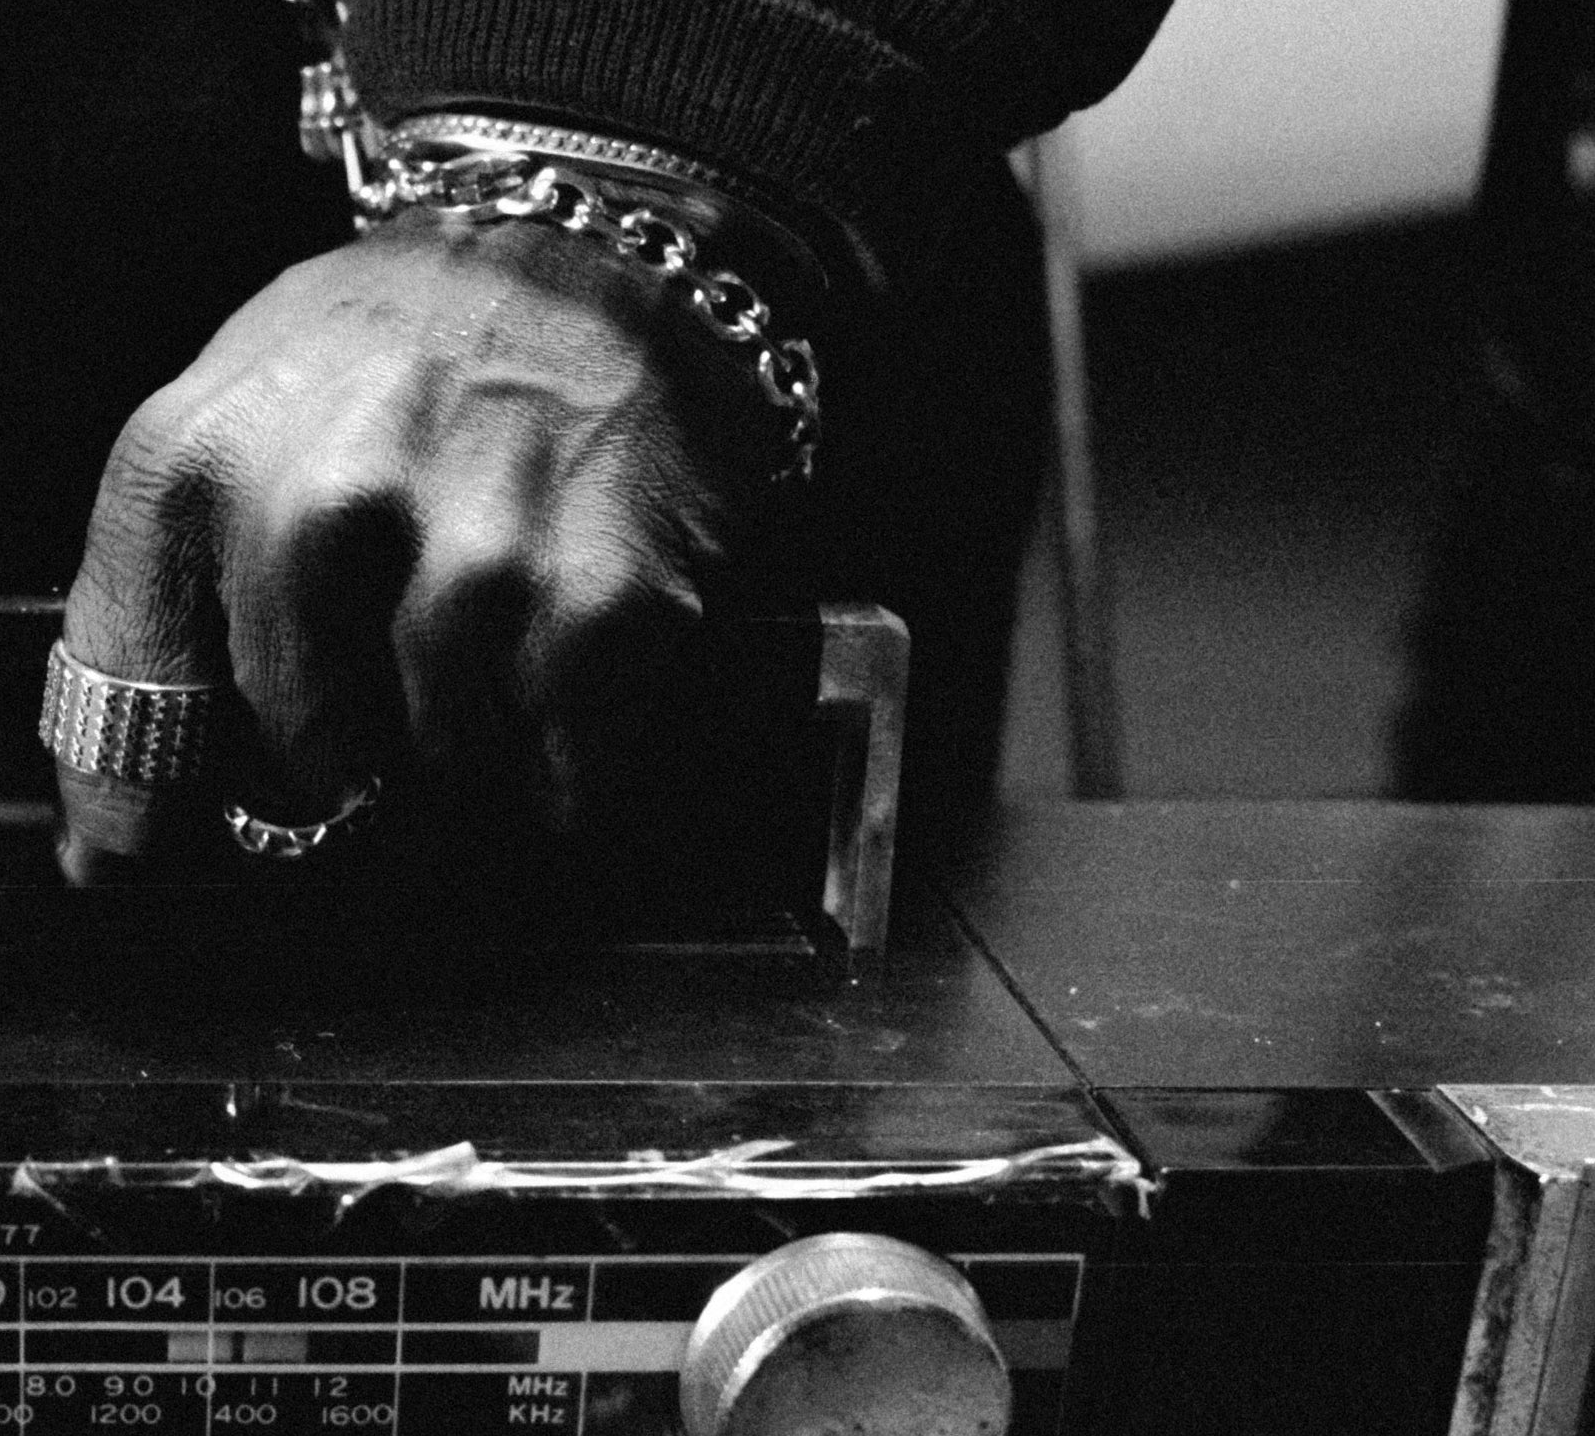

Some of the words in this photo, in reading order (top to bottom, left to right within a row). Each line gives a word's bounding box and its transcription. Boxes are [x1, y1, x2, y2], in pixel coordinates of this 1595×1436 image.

[27, 1287, 77, 1310] 102
[106, 1276, 186, 1310] 104
[213, 1287, 267, 1310] 106
[298, 1276, 378, 1310] 108
[479, 1276, 575, 1311] MHz
[180, 1375, 217, 1397] 10
[313, 1375, 349, 1397] 12
[507, 1375, 570, 1397] MHz
[90, 1403, 162, 1425] 1200
[321, 1403, 394, 1425] 1600
[508, 1404, 565, 1425] KHz
